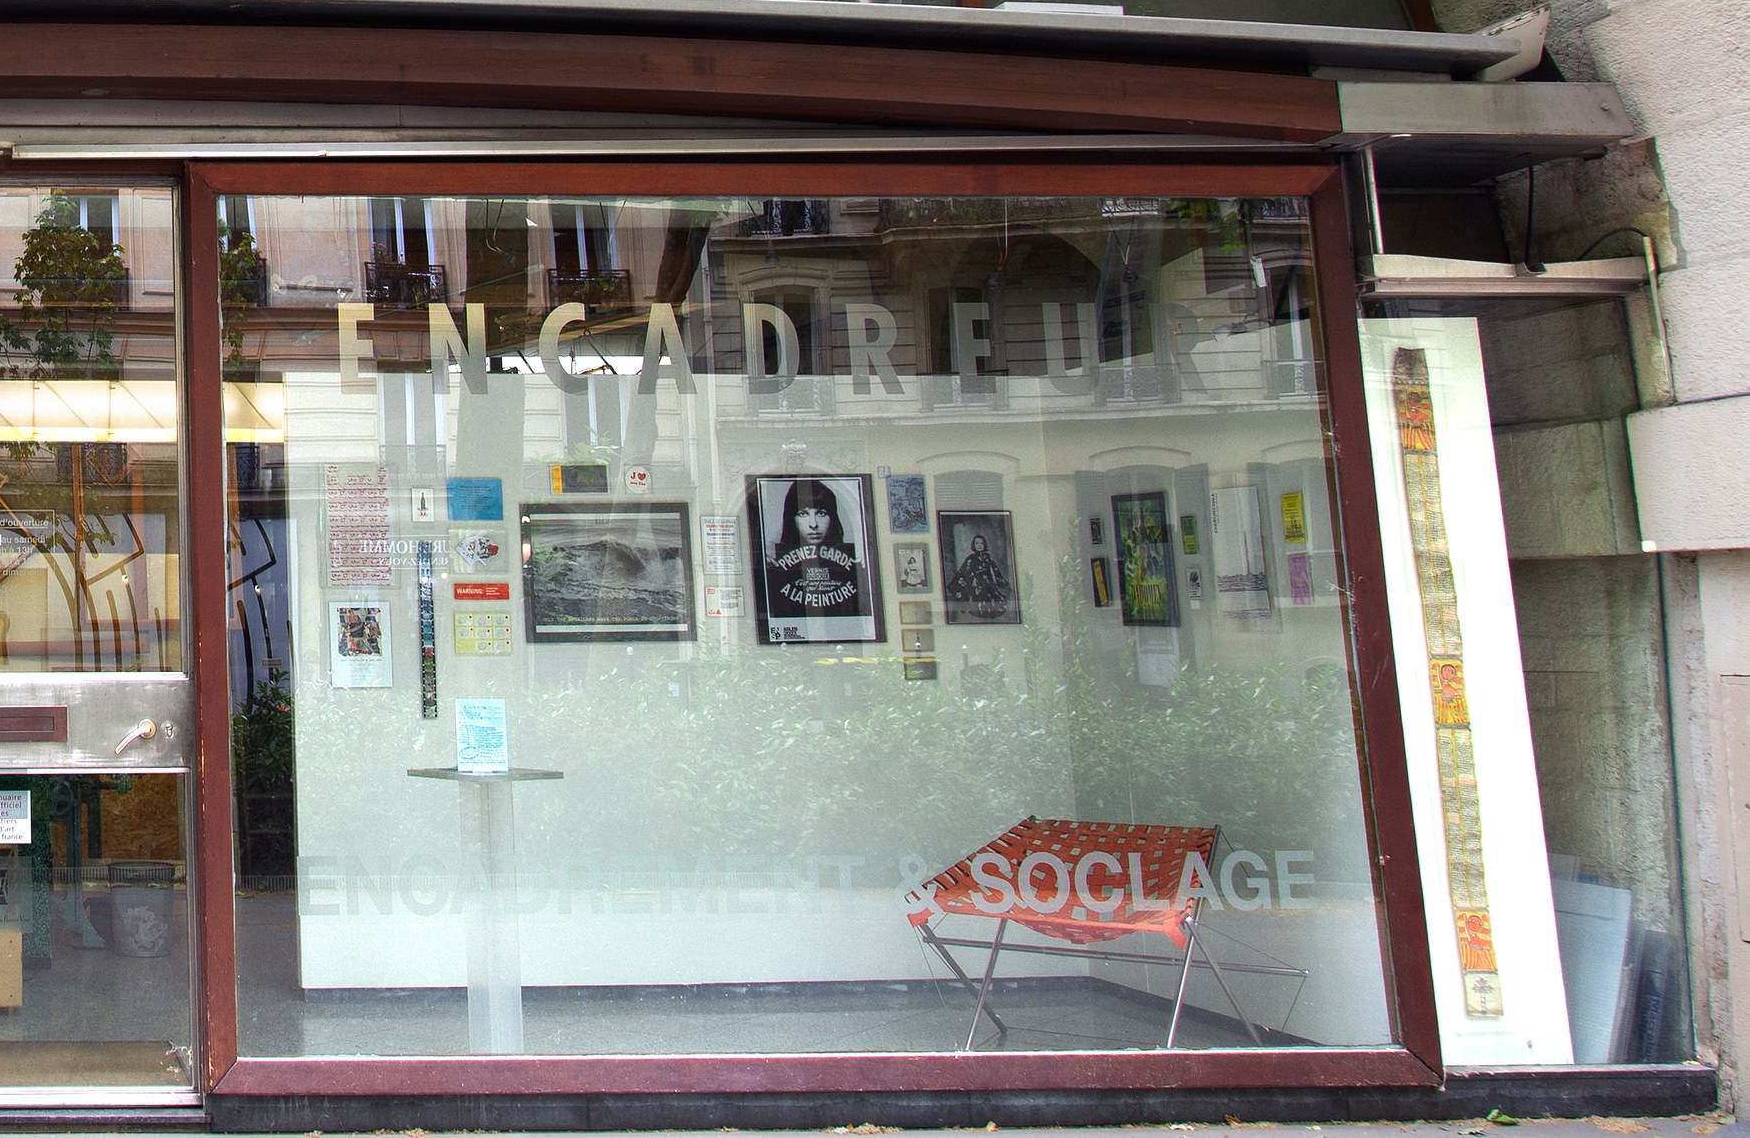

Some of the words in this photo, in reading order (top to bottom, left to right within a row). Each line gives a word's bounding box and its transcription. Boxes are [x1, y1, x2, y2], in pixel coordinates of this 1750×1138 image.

[338, 302, 1208, 396] ENCADREUR
[0, 518, 49, 528] d'ouverture
[14, 536, 46, 544] samedi
[778, 545, 818, 571] PRENEZ
[819, 546, 854, 571] GARDE
[780, 583, 791, 597] A
[790, 588, 803, 604] LA
[804, 581, 857, 607] PEINTURE
[297, 854, 869, 917] ENCADREMENT
[895, 853, 939, 915] &
[970, 849, 1316, 913] SOCLAGE
